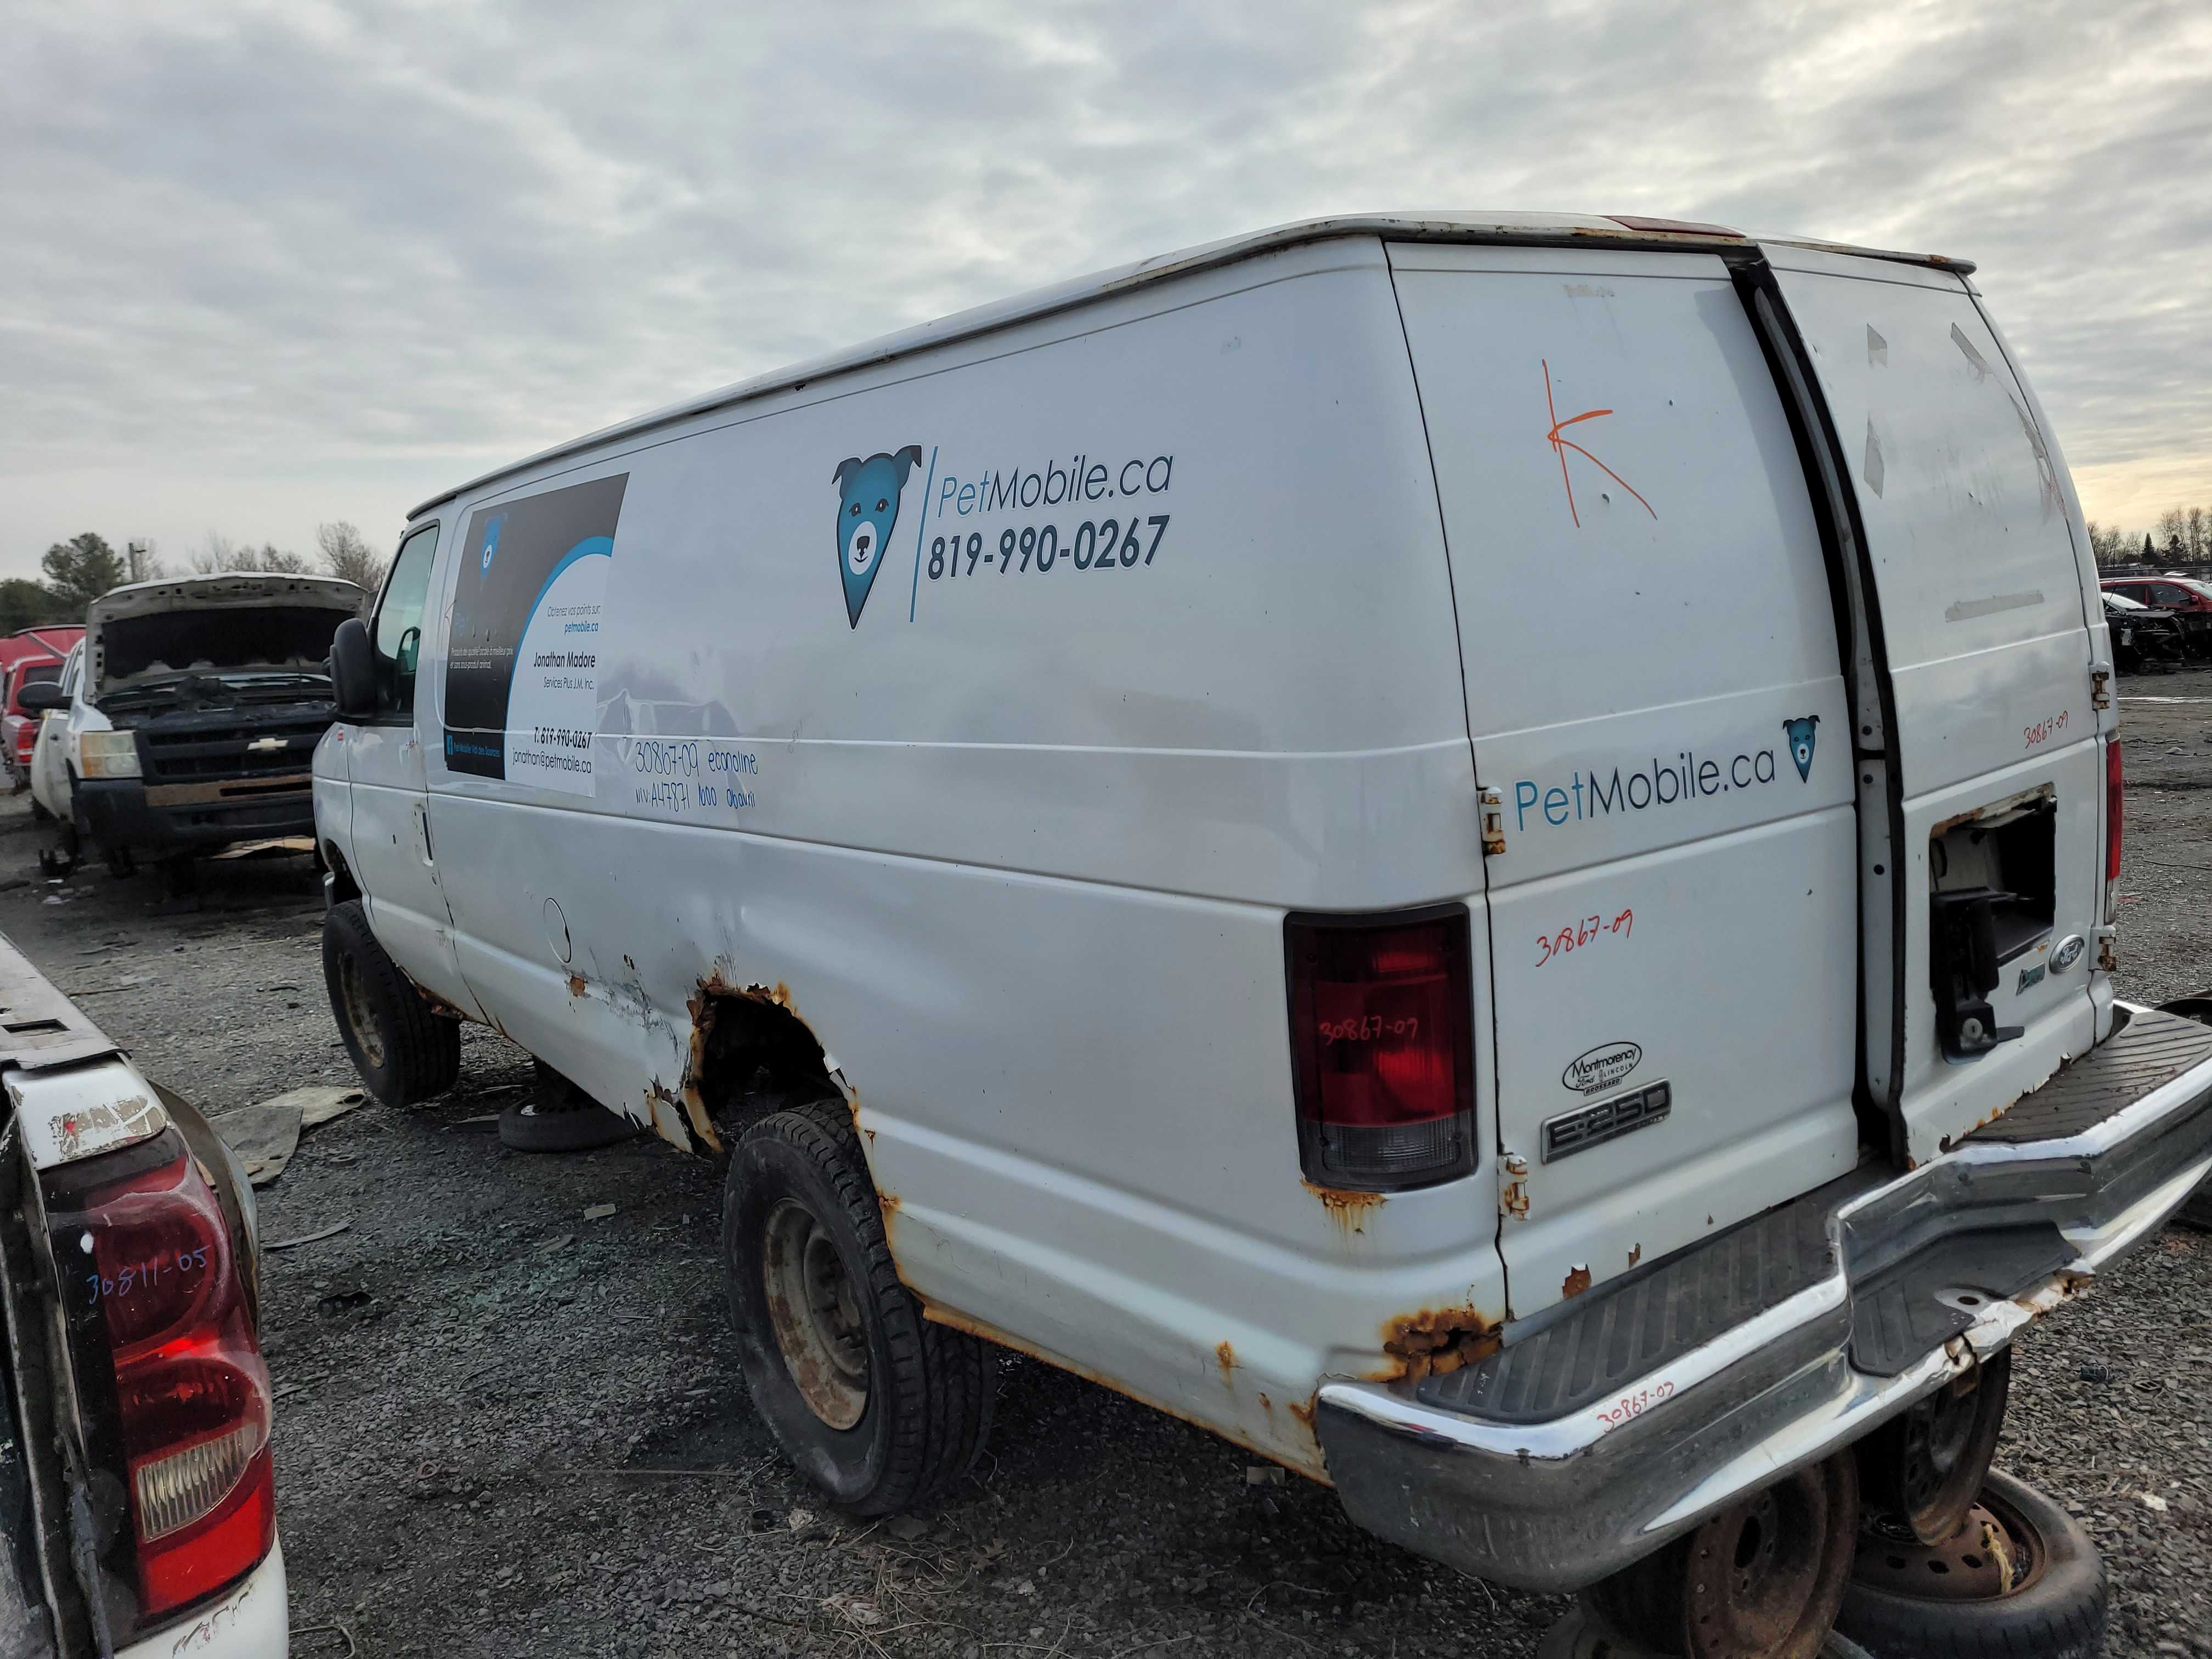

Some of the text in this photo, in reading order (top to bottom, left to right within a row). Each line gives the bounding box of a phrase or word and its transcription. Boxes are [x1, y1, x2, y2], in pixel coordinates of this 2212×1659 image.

[1541, 358, 1658, 528] K
[937, 454, 1174, 519] PetMobile.ca
[927, 514, 1171, 581] 819-990-0267
[548, 605, 568, 617] Obtenez
[568, 606, 576, 616] vos
[576, 603, 591, 617] points
[563, 620, 599, 636] petmobile.ca
[533, 651, 596, 668] Jonathan Madore
[543, 676, 594, 690] Services Plus J.M. Inc.
[540, 727, 593, 749] 819-990-0267
[512, 747, 592, 774] jonathan@petmobile.ca
[635, 741, 759, 777] 30867-09 econoline
[1514, 748, 1776, 833] PetMobile.ca
[1572, 1048, 1637, 1079] Montmorency
[1604, 1062, 1633, 1078] LINCOLN
[1576, 1074, 1595, 1088] Ford
[1585, 1076, 1621, 1095] BROSSARD
[86, 1243, 211, 1305] 30811-05
